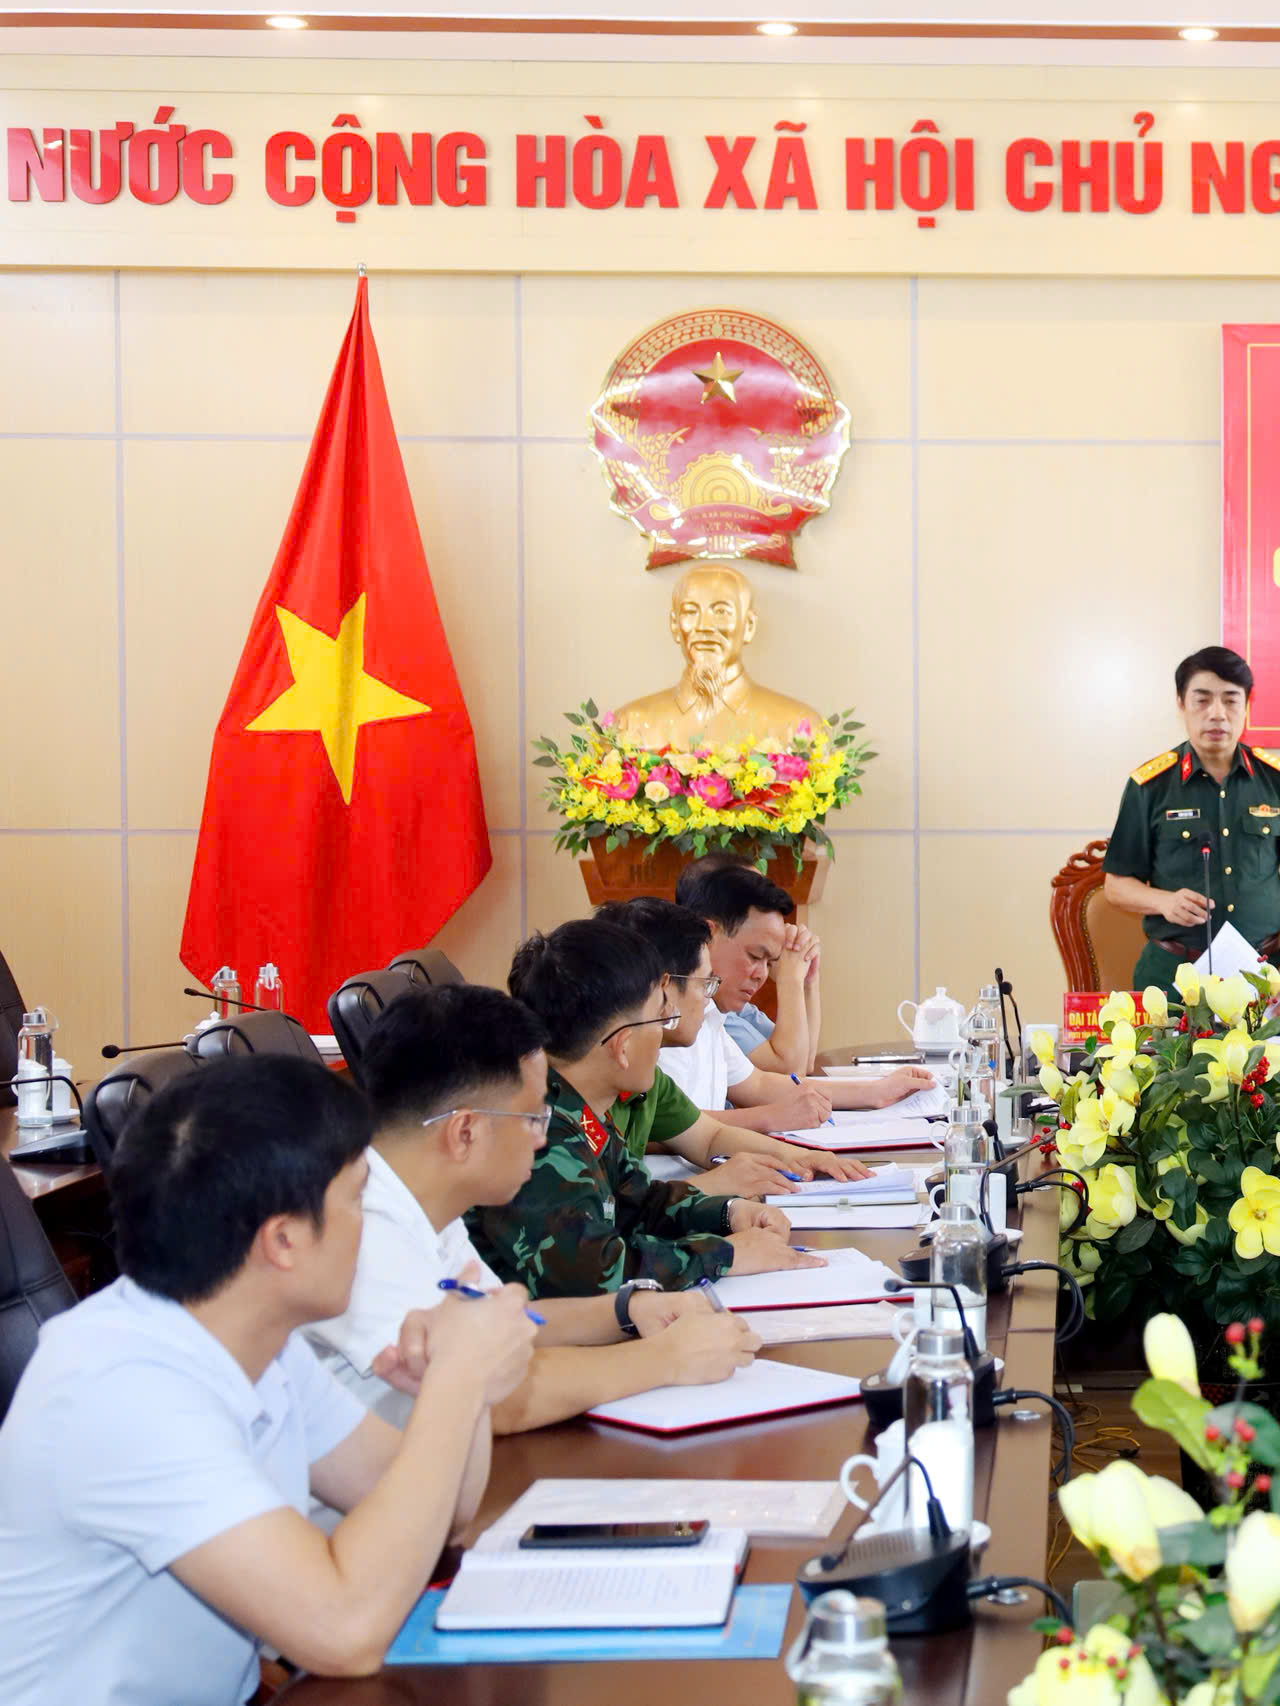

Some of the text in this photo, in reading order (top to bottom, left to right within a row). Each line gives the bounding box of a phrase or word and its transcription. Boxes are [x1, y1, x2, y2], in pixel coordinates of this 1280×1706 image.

[7, 105, 234, 205] NƯỚC
[265, 113, 487, 223] CỘNG
[515, 115, 680, 210] HÒA
[704, 120, 819, 210] XÃ
[844, 118, 975, 229] HỘI
[1005, 110, 1164, 215] CHỦ
